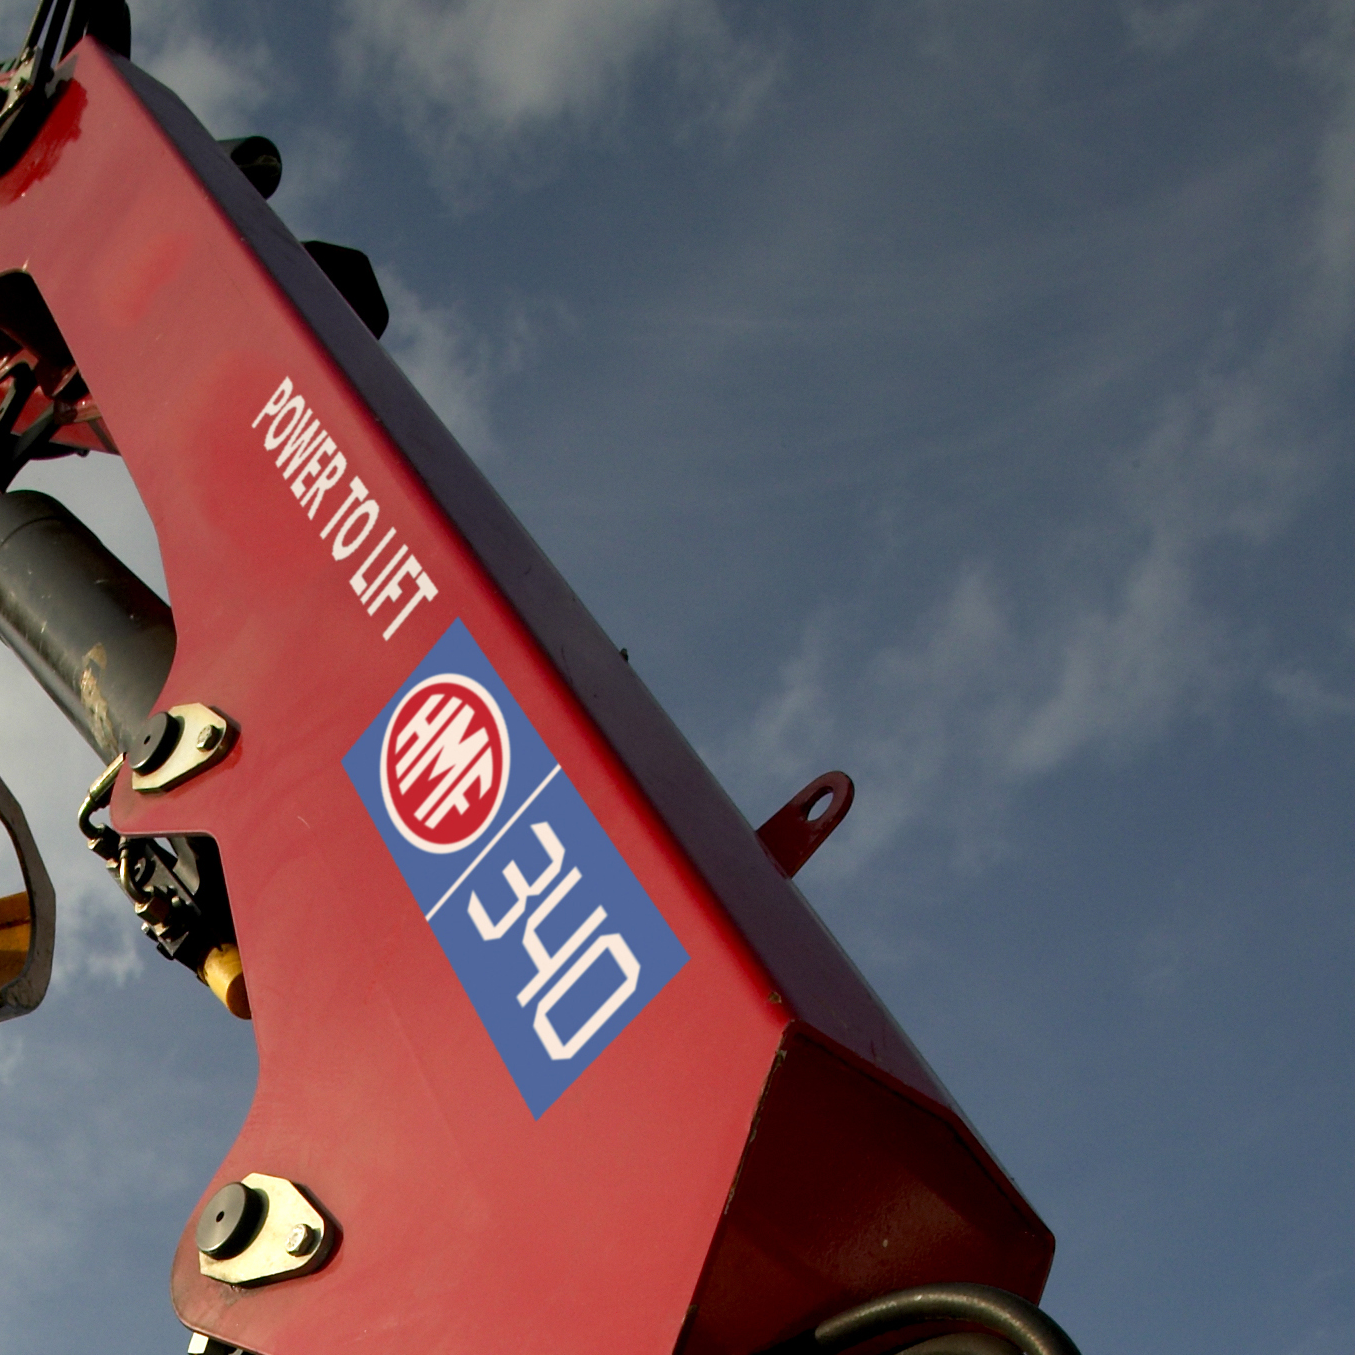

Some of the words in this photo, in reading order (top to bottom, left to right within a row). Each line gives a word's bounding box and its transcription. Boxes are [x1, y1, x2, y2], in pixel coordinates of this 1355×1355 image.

[252, 375, 348, 520] POWER
[320, 475, 379, 562] TO
[349, 527, 438, 641] LIFT
[394, 694, 496, 830] HMF
[467, 821, 641, 1061] 340
